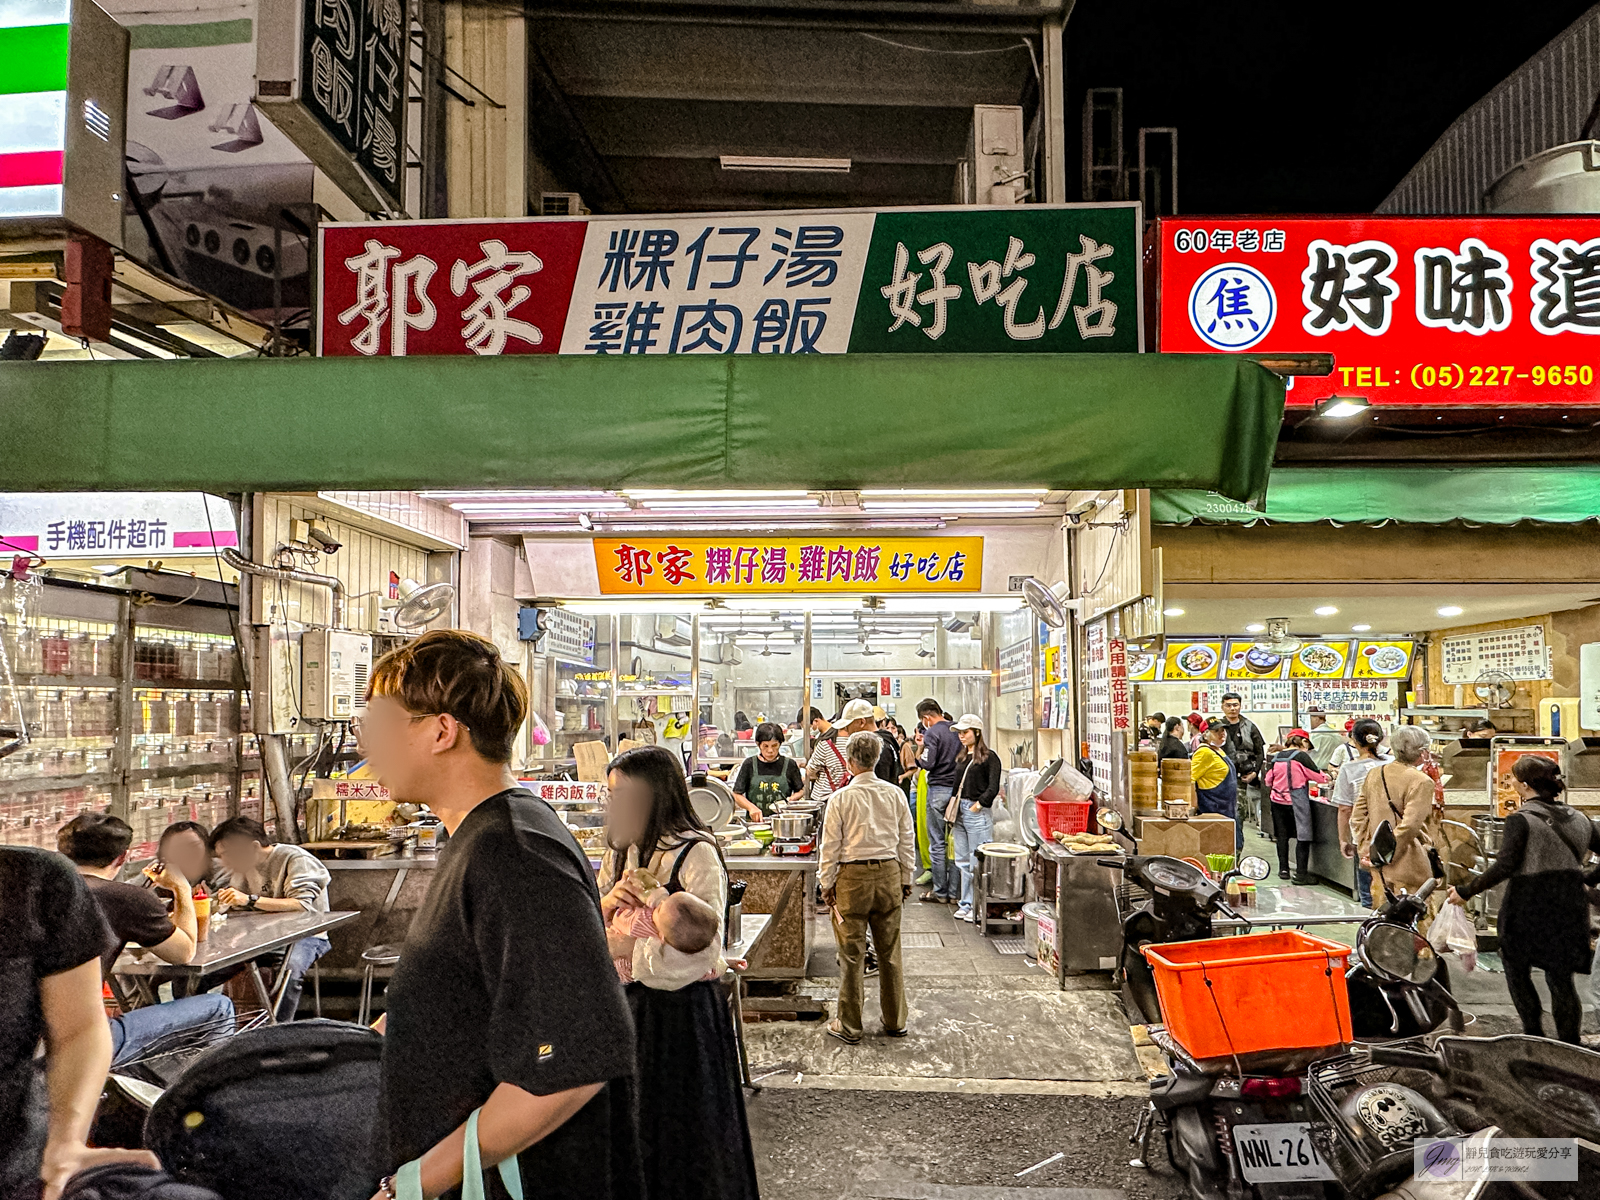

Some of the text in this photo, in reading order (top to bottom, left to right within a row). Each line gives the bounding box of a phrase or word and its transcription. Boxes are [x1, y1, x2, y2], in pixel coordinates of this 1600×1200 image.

[1173, 228, 1286, 253] 60年老店
[338, 225, 1118, 354] 郭家 粿仔湯 好吃店
[1206, 277, 1259, 334] 焦
[1303, 240, 1600, 334] 好味道
[585, 297, 832, 354] 雞肉飯
[1410, 363, 1593, 389] (05)227-9650
[46, 518, 168, 551] 手機配件超市
[613, 543, 696, 587] 郭家
[888, 550, 967, 582] 好吃店
[1109, 638, 1130, 730] 內用請在此排隊
[1302, 691, 1388, 702] 60年老店在外無分店
[540, 785, 584, 800] 雞肉飯
